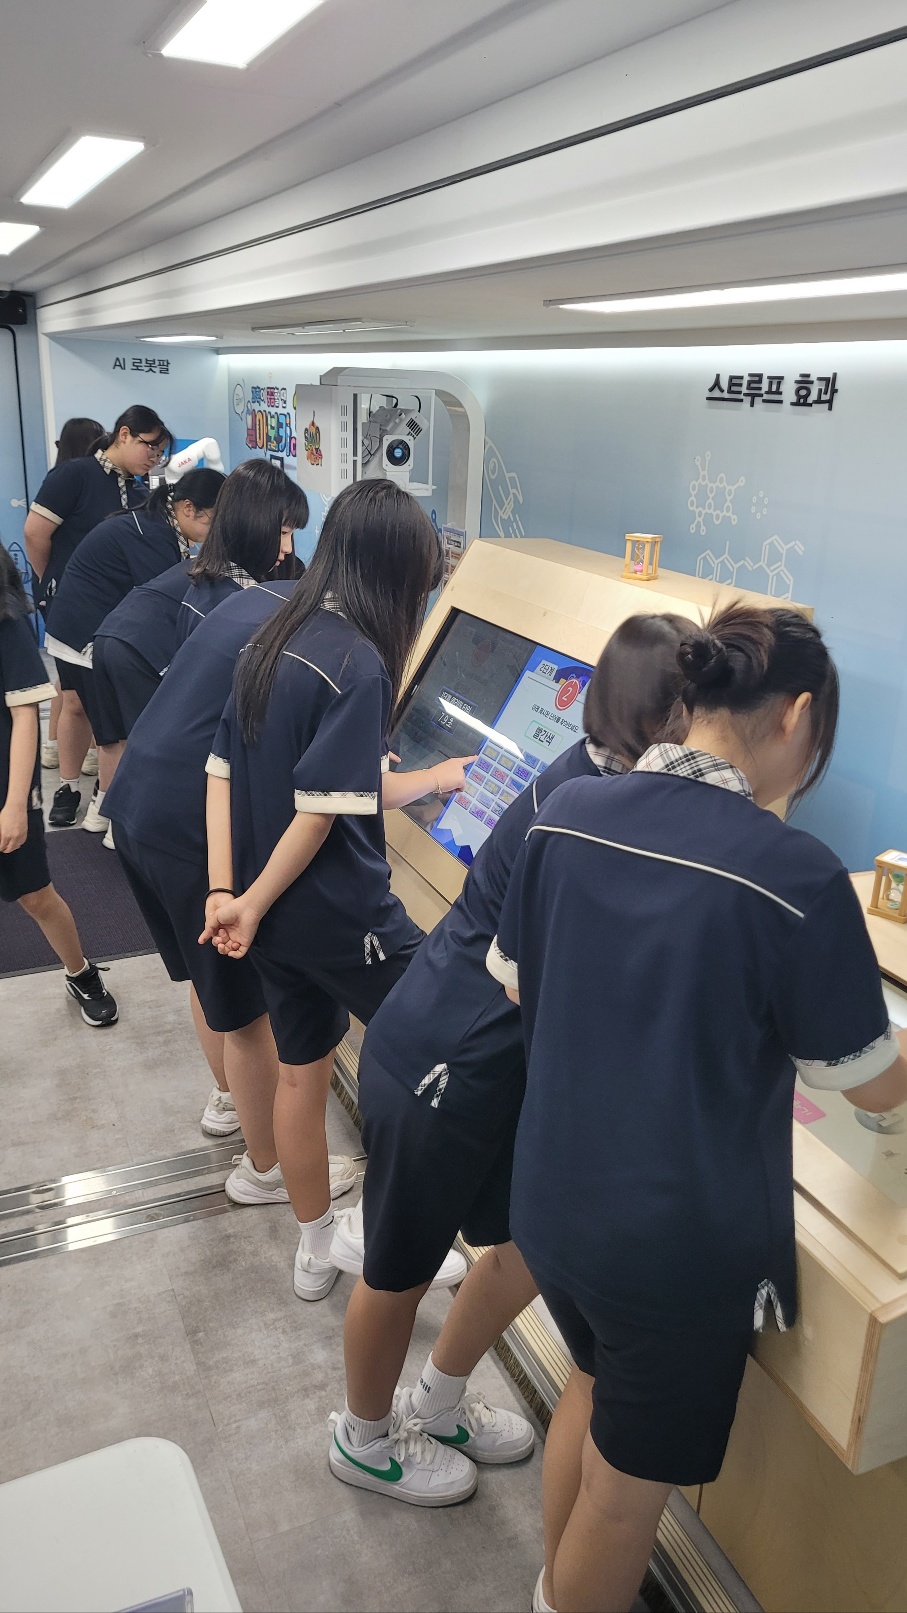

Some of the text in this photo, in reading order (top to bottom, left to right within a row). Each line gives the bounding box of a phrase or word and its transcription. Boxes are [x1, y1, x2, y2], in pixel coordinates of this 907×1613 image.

[113, 357, 171, 375] AI 로봇팔
[266, 385, 280, 408] 궁금할
[705, 371, 839, 411] 스트루프 효과
[177, 457, 192, 468] JAKA
[539, 663, 556, 677] 2단계
[561, 687, 573, 701] 2
[532, 725, 556, 747] 빨간색
